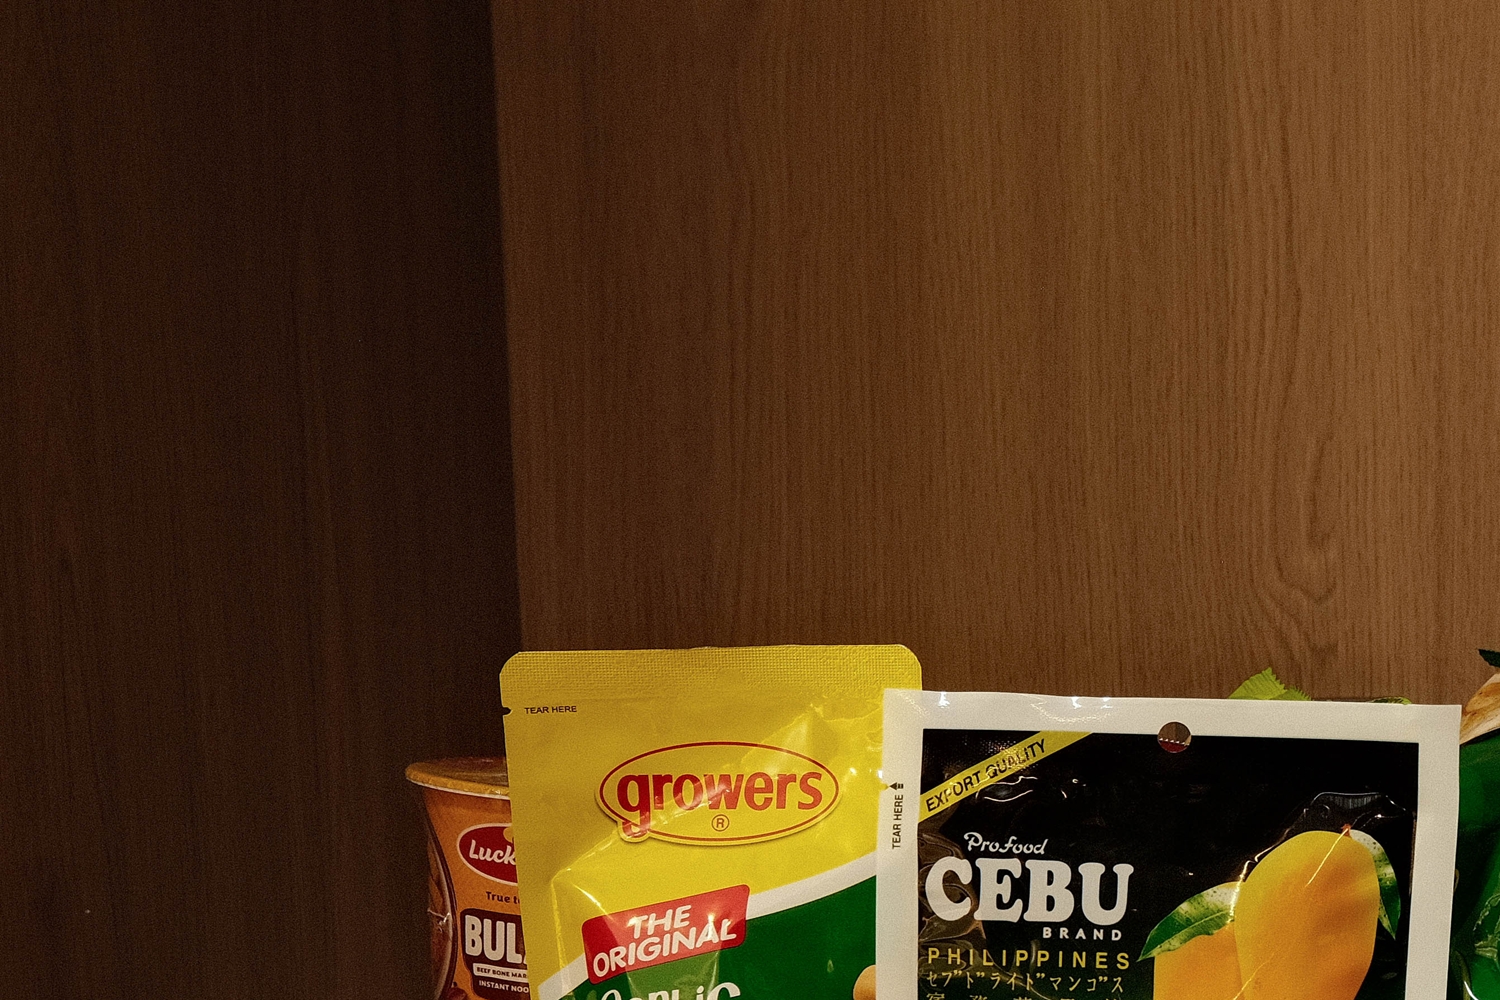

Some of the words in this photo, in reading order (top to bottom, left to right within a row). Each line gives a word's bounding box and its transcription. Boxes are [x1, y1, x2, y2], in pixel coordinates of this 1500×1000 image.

[524, 706, 549, 715] TEAR
[552, 705, 577, 714] HERE
[925, 771, 981, 813] EXPORT
[985, 738, 1046, 779] QUALITY
[616, 771, 823, 838] growers
[893, 794, 904, 821] HERE
[892, 823, 902, 850] TEAR
[486, 891, 511, 904] True
[925, 855, 1135, 926] CEBU
[629, 904, 692, 939] THE
[1042, 926, 1123, 941] BRAND
[464, 914, 526, 965] BUL
[593, 918, 737, 978] ORIGINAL
[927, 947, 1130, 970] PHILIPPINES
[476, 966, 491, 975] BEEF
[492, 968, 510, 977] BONE
[511, 970, 528, 979] MAR
[479, 980, 509, 991] INSTANT
